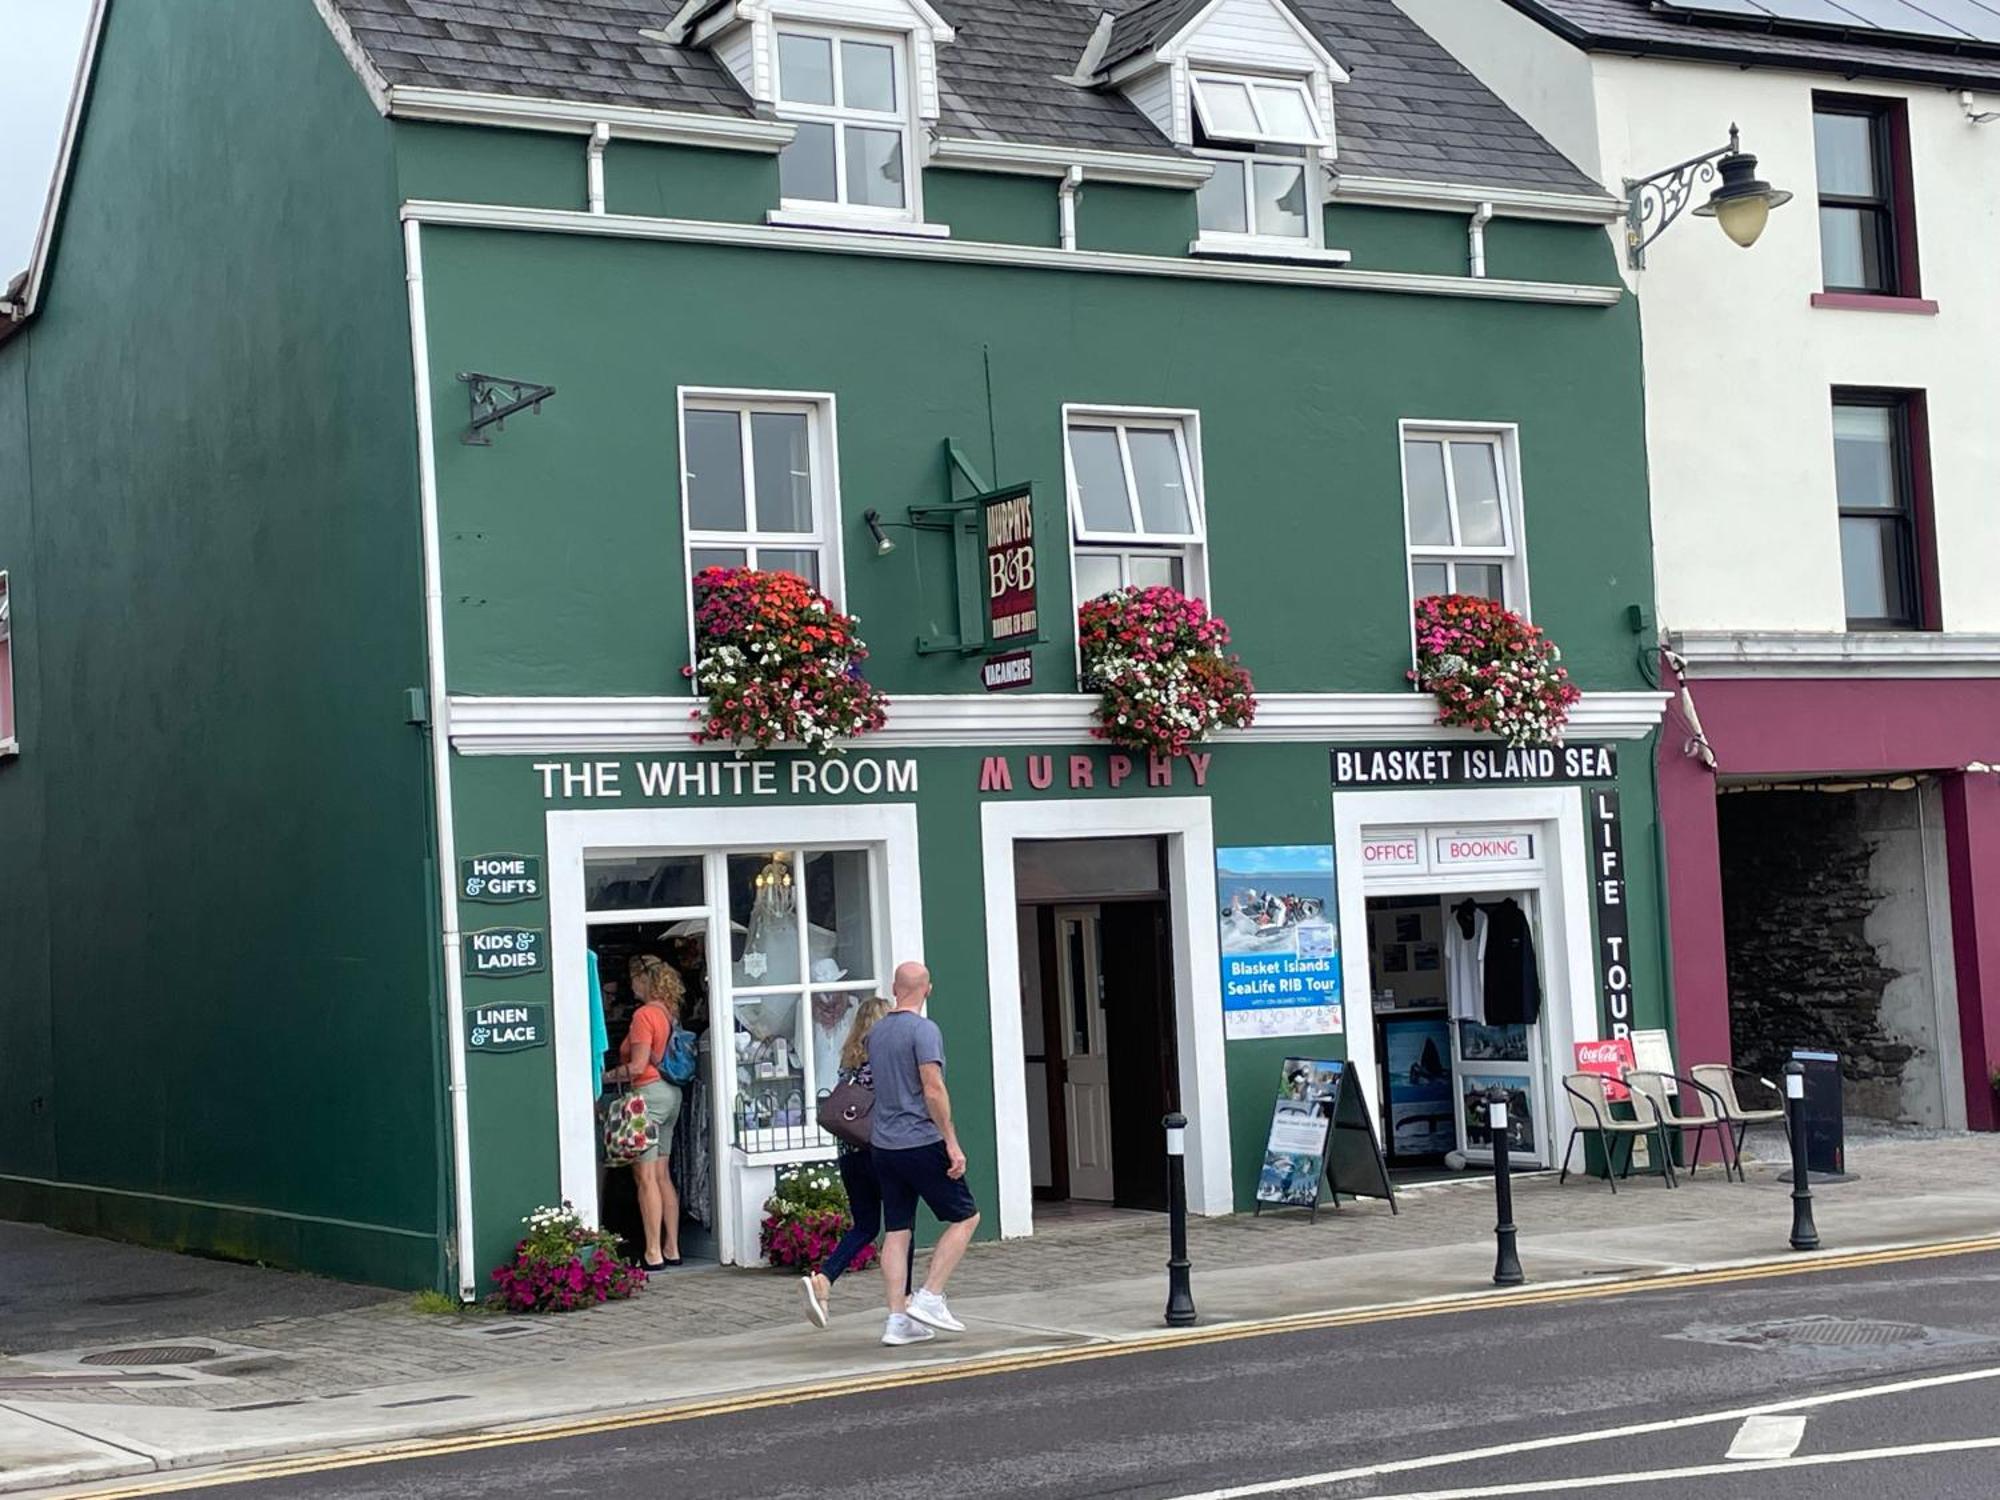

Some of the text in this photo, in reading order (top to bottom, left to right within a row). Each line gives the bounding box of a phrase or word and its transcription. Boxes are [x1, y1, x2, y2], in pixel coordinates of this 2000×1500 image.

[989, 546, 1034, 598] B&B
[985, 658, 1031, 686] VACANCIES
[980, 752, 1211, 791] MURPHY
[1336, 748, 1612, 781] BLASKET ISLAND SEA
[533, 758, 918, 798] THE WHITE ROOM
[1364, 844, 1414, 860] OFFICE
[1451, 841, 1518, 858] BOOKING
[1599, 795, 1620, 904] LIFE
[474, 860, 525, 875] HOME
[466, 877, 536, 896] & GIFTS
[474, 932, 536, 951] KIDS &
[478, 952, 536, 969] LADIES
[1231, 959, 1330, 976] Blasket Islands
[1227, 977, 1336, 996] SeaLife RIB Tour
[477, 1008, 527, 1025] LINEN
[471, 1026, 536, 1046] & LACE
